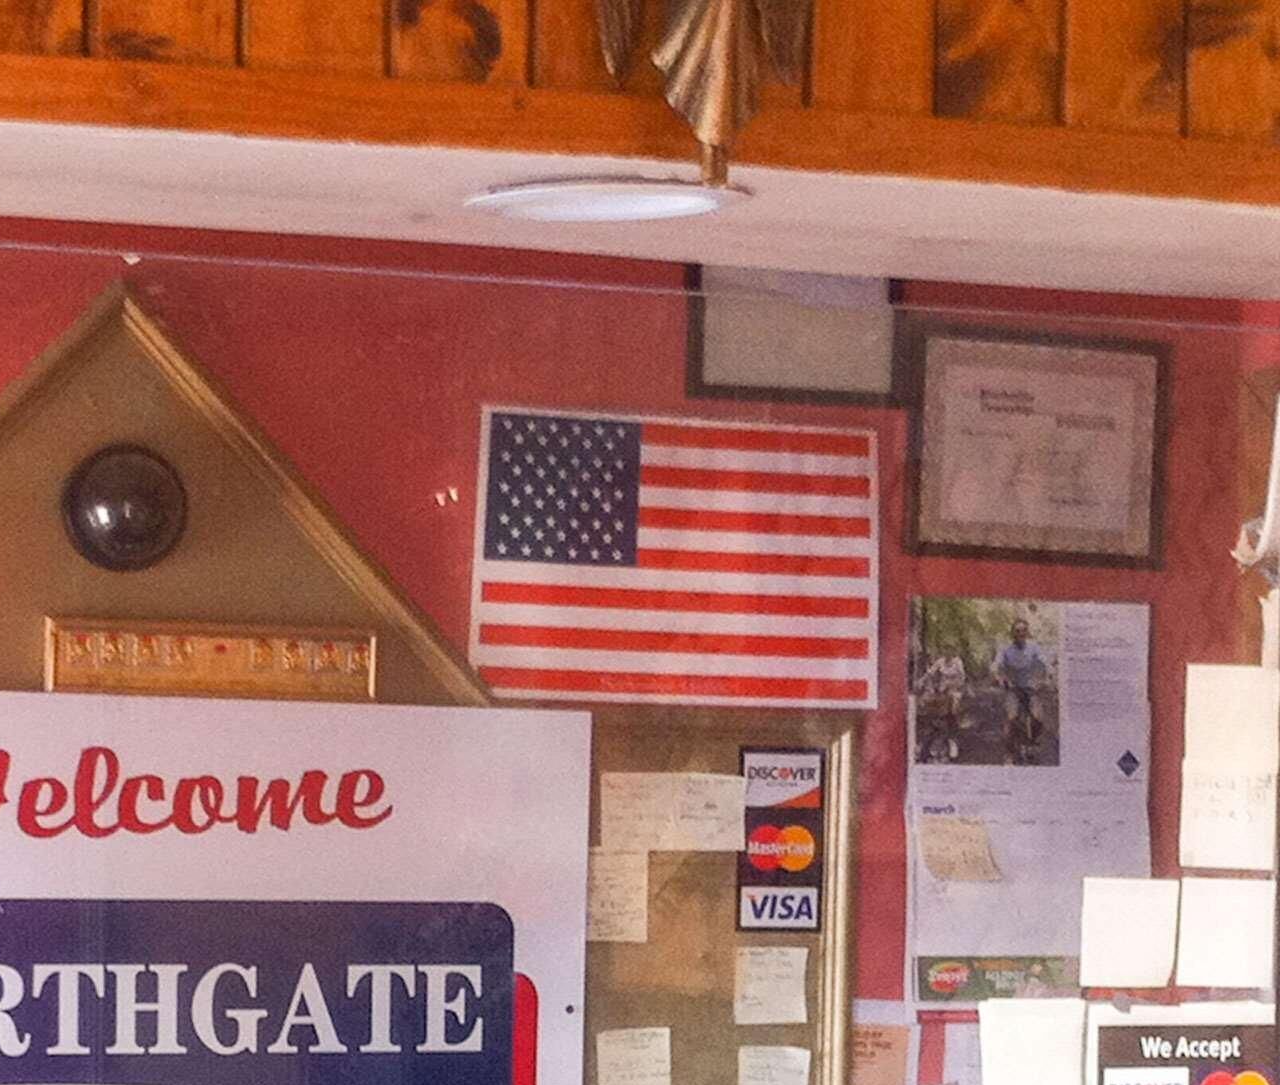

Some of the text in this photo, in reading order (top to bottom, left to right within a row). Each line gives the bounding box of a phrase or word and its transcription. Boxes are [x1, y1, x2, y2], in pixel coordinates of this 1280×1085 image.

[748, 766, 817, 782] DISCOVER
[747, 894, 814, 920] VISA
[1140, 1035, 1242, 1063] We Accept
